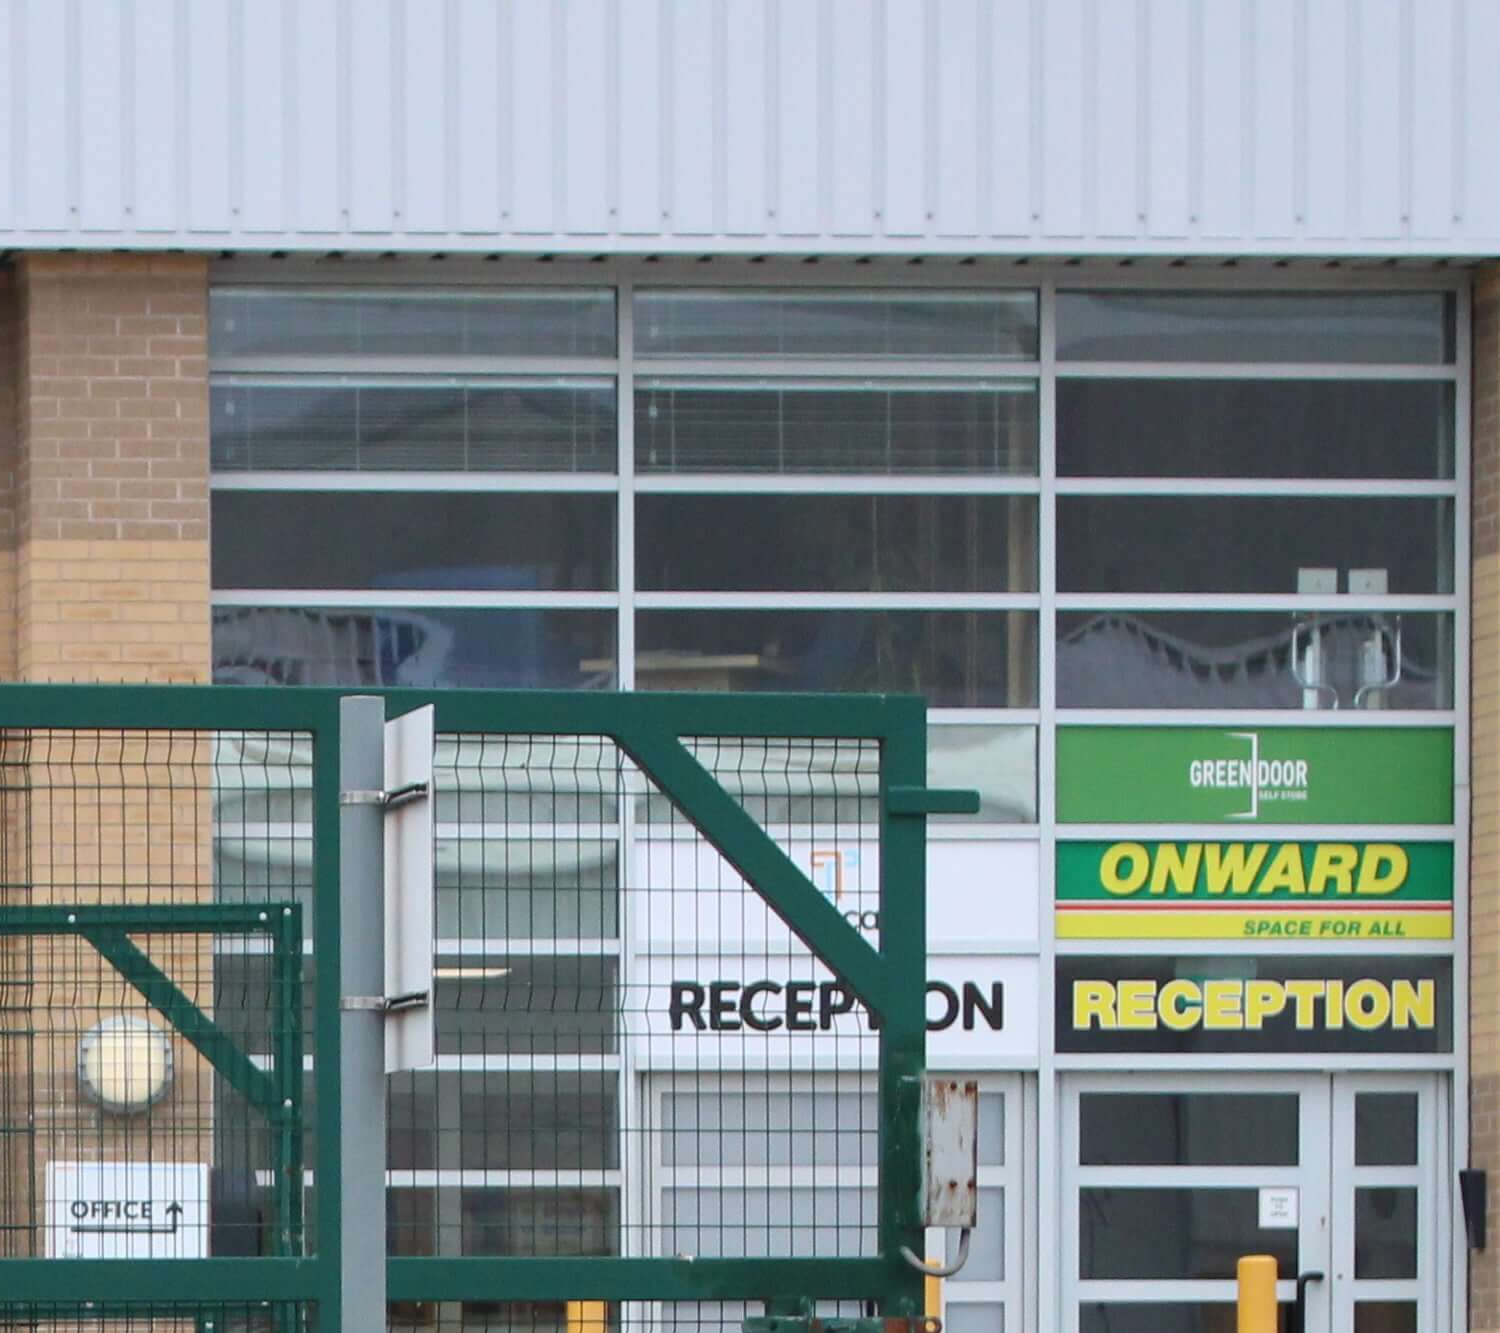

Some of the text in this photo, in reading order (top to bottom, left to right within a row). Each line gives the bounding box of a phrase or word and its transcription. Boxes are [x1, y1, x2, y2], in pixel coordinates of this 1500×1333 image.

[1190, 760, 1307, 787] GREEN DOOR
[1100, 841, 1410, 895] ONWARD
[1243, 920, 1405, 936] SPACE FOR ALL
[670, 981, 1003, 1031] RECEPON
[1072, 979, 1434, 1030] RECEPTION
[71, 1201, 152, 1218] OFFICE
